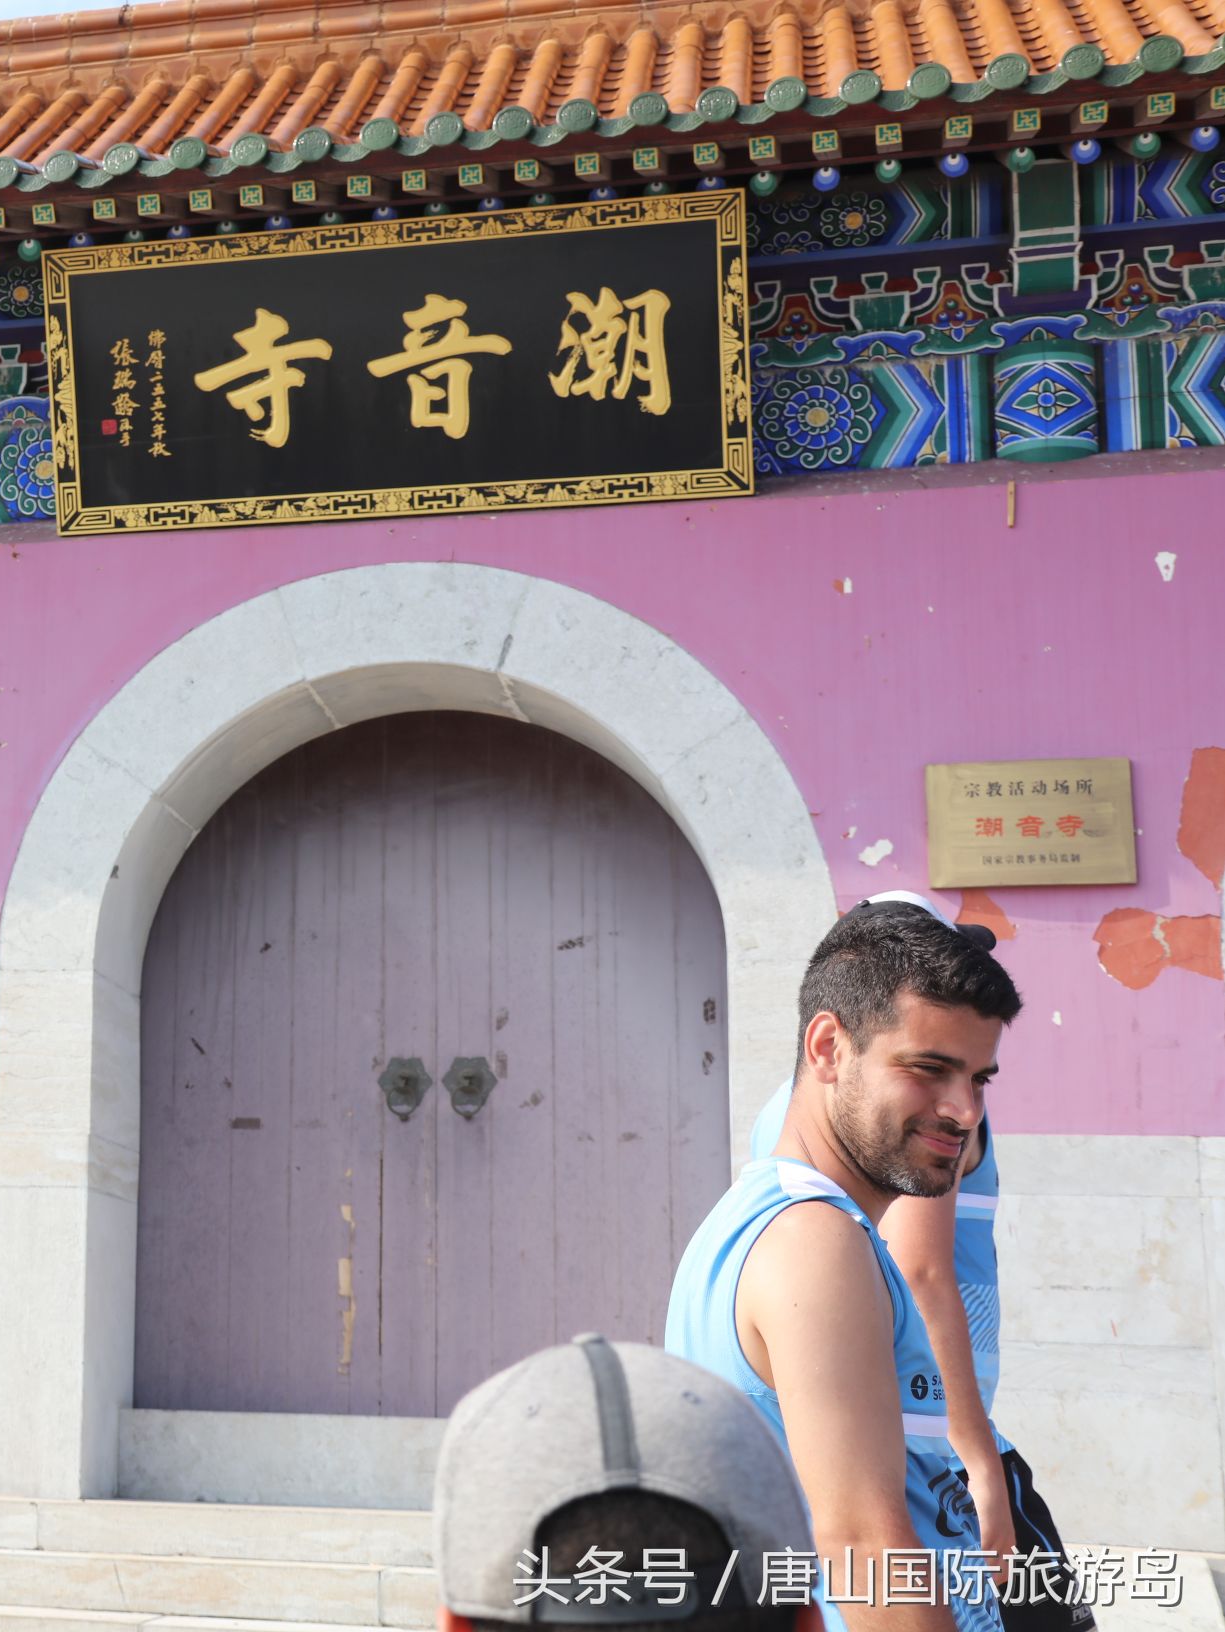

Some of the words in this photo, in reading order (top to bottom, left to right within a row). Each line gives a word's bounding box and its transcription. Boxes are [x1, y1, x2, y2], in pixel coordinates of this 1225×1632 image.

[964, 778, 1094, 798] 宗教活动场所
[975, 814, 1085, 838] 潮音寺
